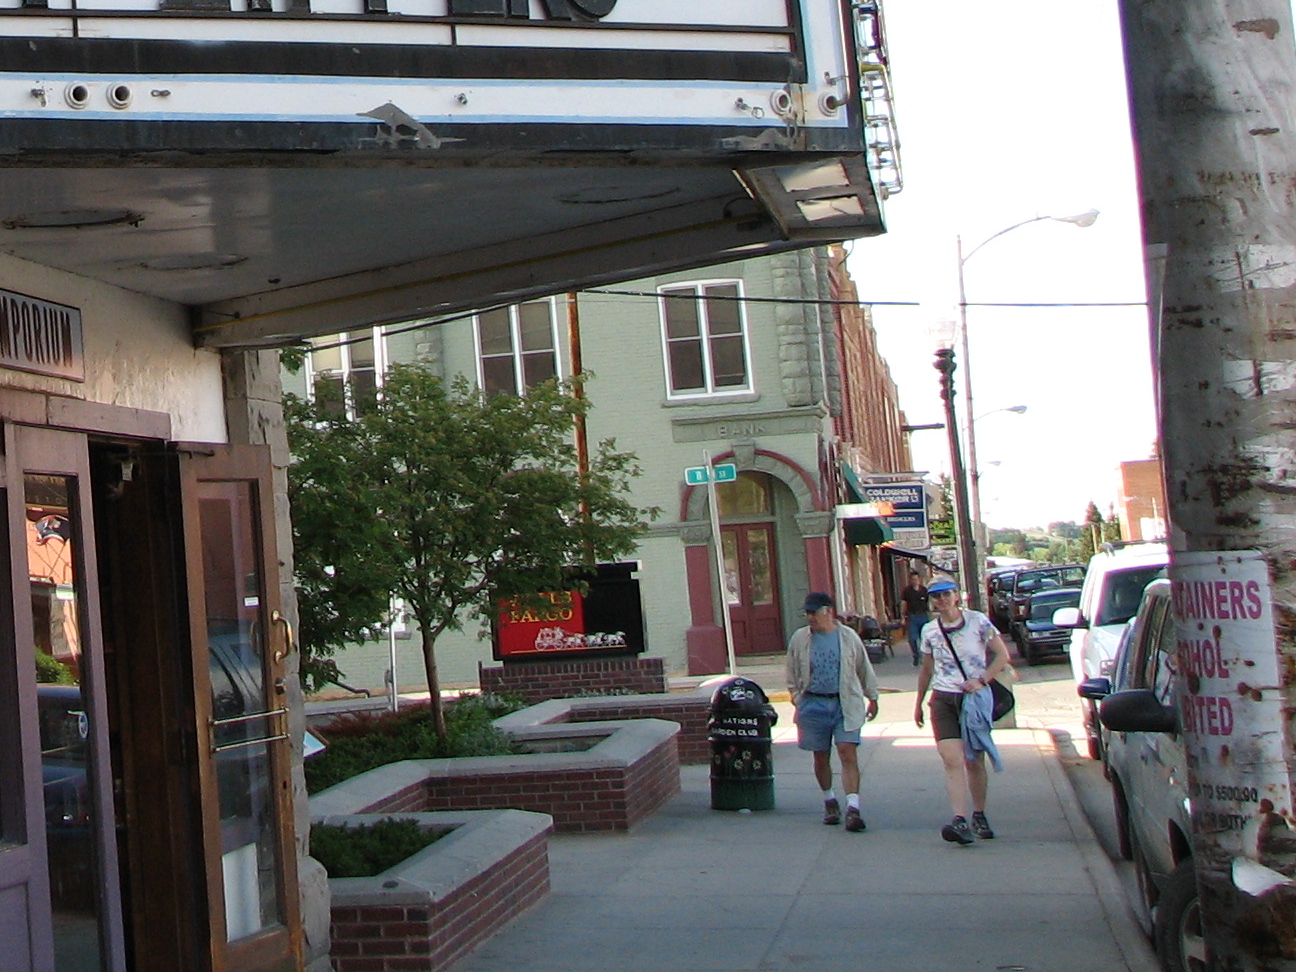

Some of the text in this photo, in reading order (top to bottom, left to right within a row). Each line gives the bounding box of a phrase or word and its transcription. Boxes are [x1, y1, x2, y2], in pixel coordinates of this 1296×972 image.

[717, 423, 765, 437] BANK
[866, 488, 918, 496] COLDWELL
[510, 608, 572, 623] FAGO
